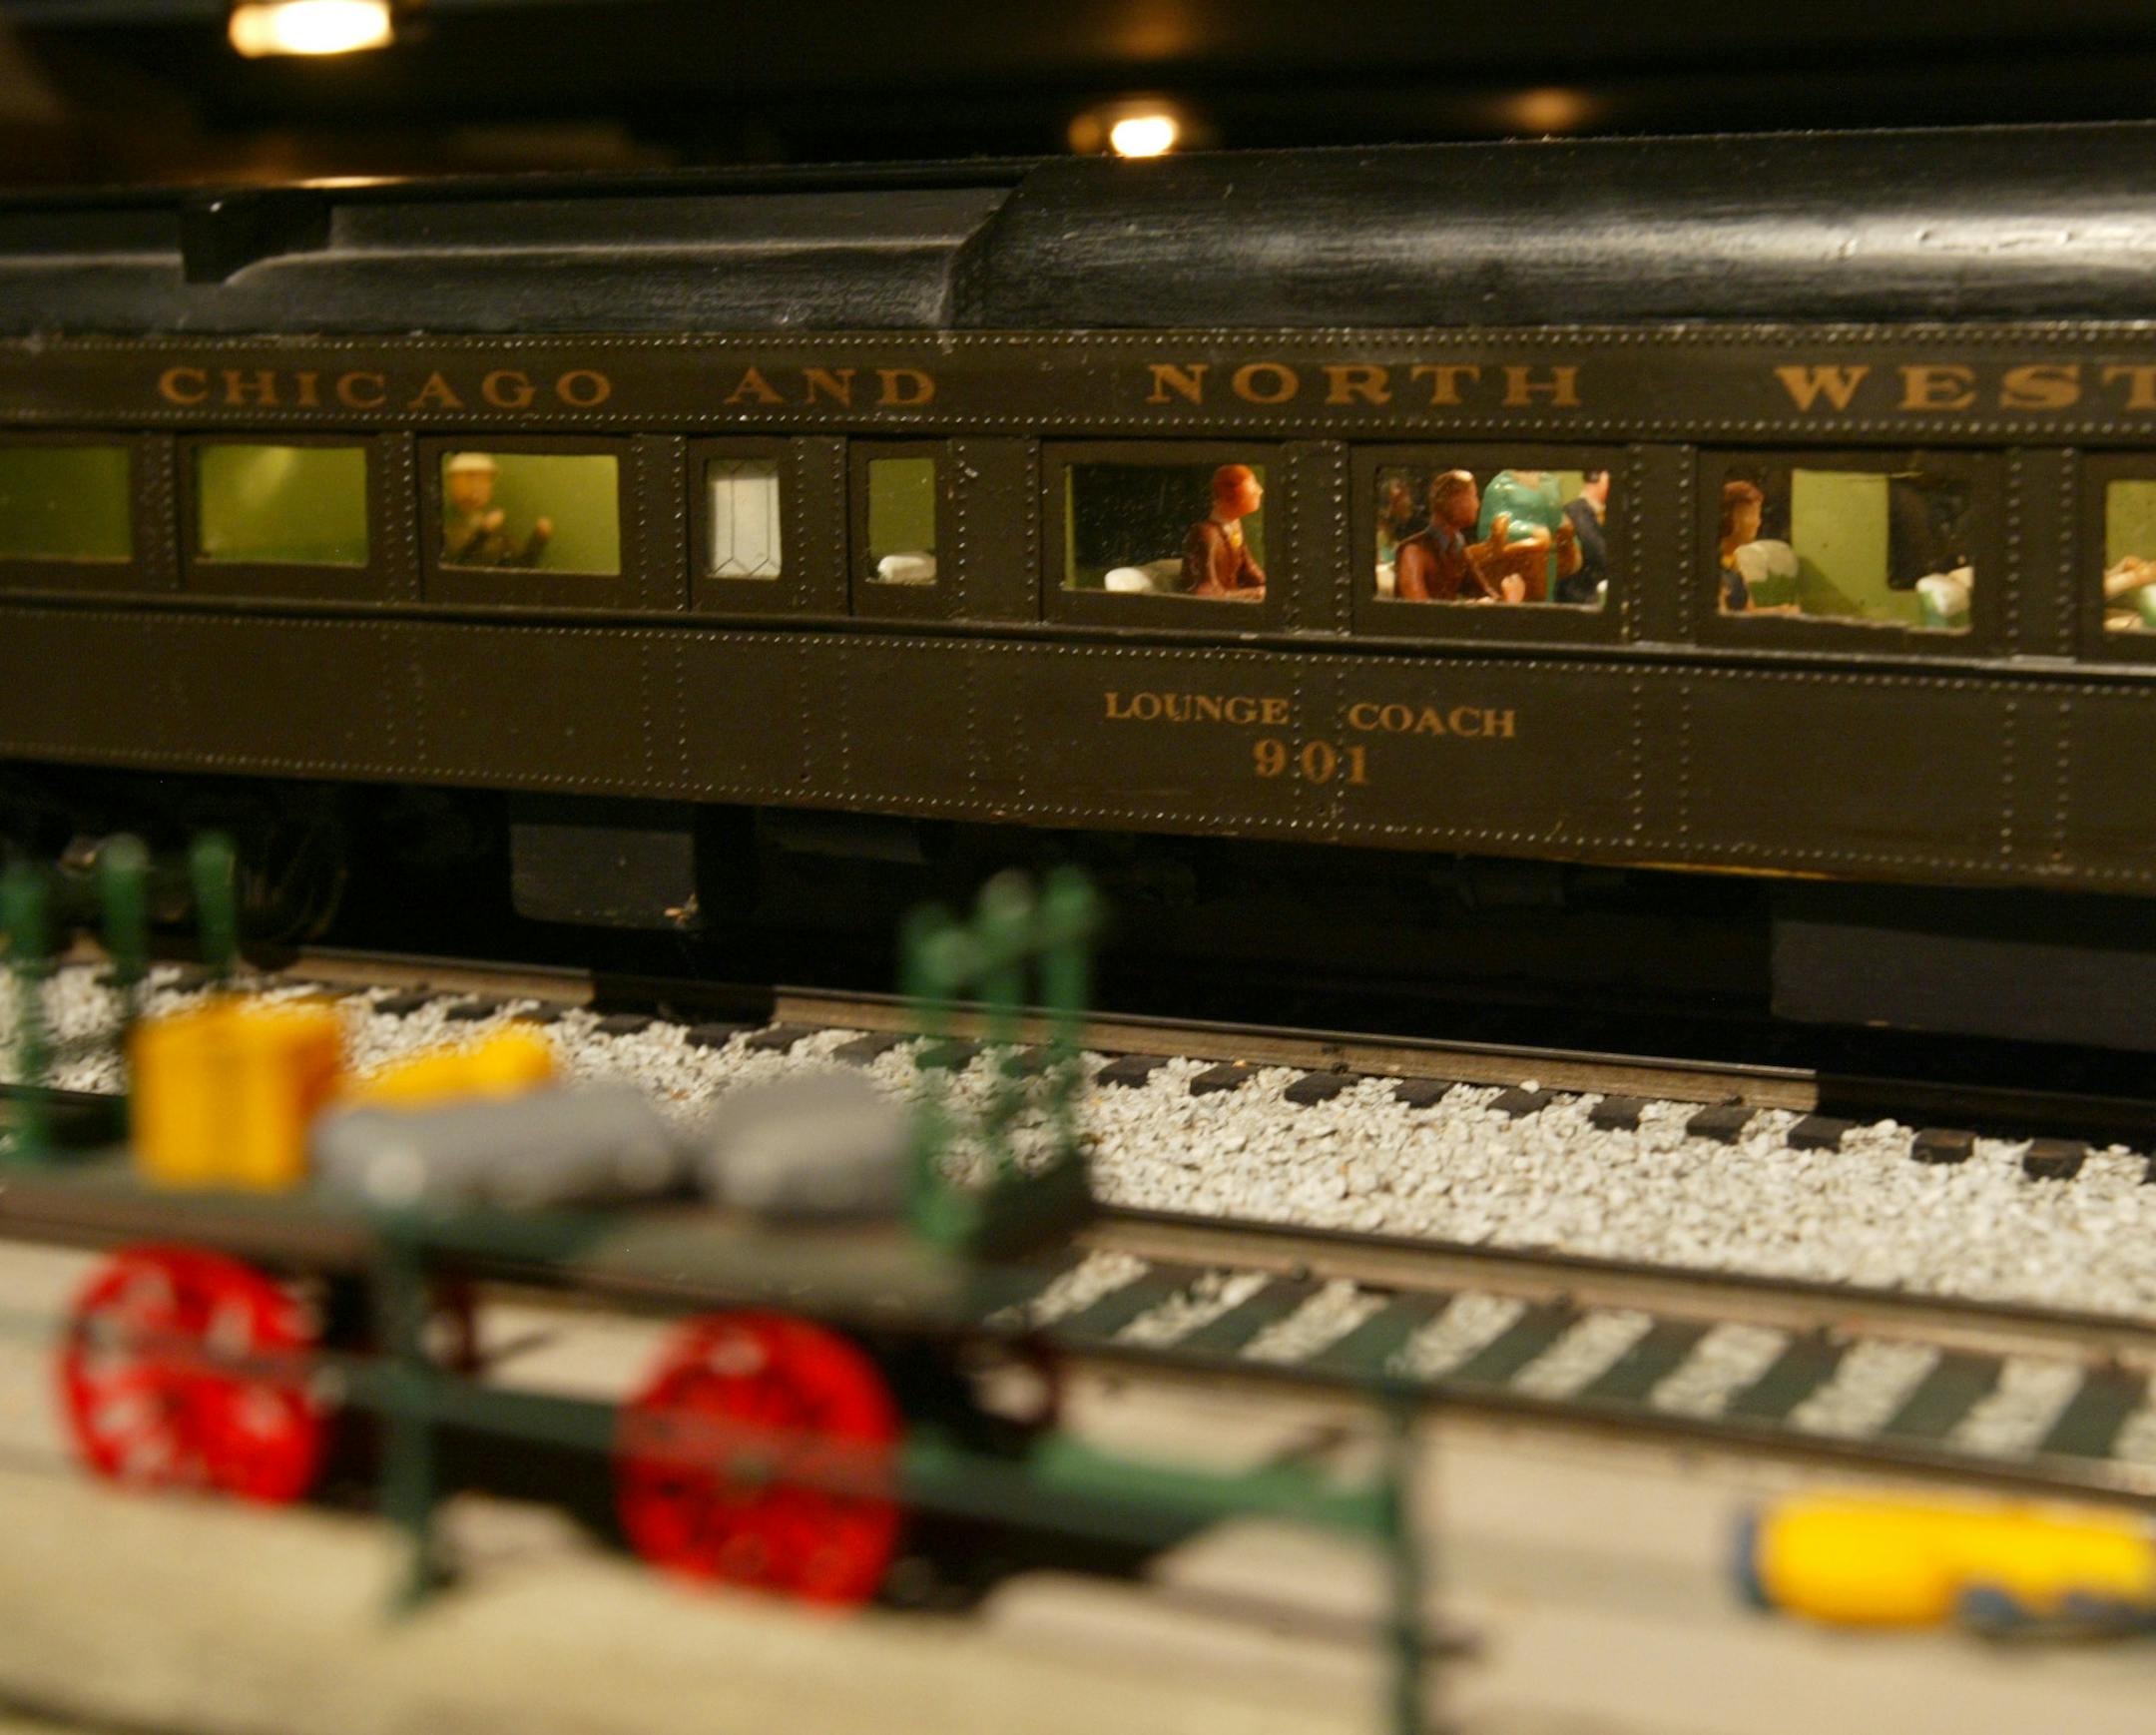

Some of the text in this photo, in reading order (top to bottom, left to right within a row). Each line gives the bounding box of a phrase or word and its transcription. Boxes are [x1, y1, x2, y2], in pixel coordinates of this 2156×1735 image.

[158, 362, 2156, 412] CHICAGO AND NORTH WEST
[1104, 692, 1516, 738] LOUNGE COACH
[1251, 739, 1368, 786] 901
